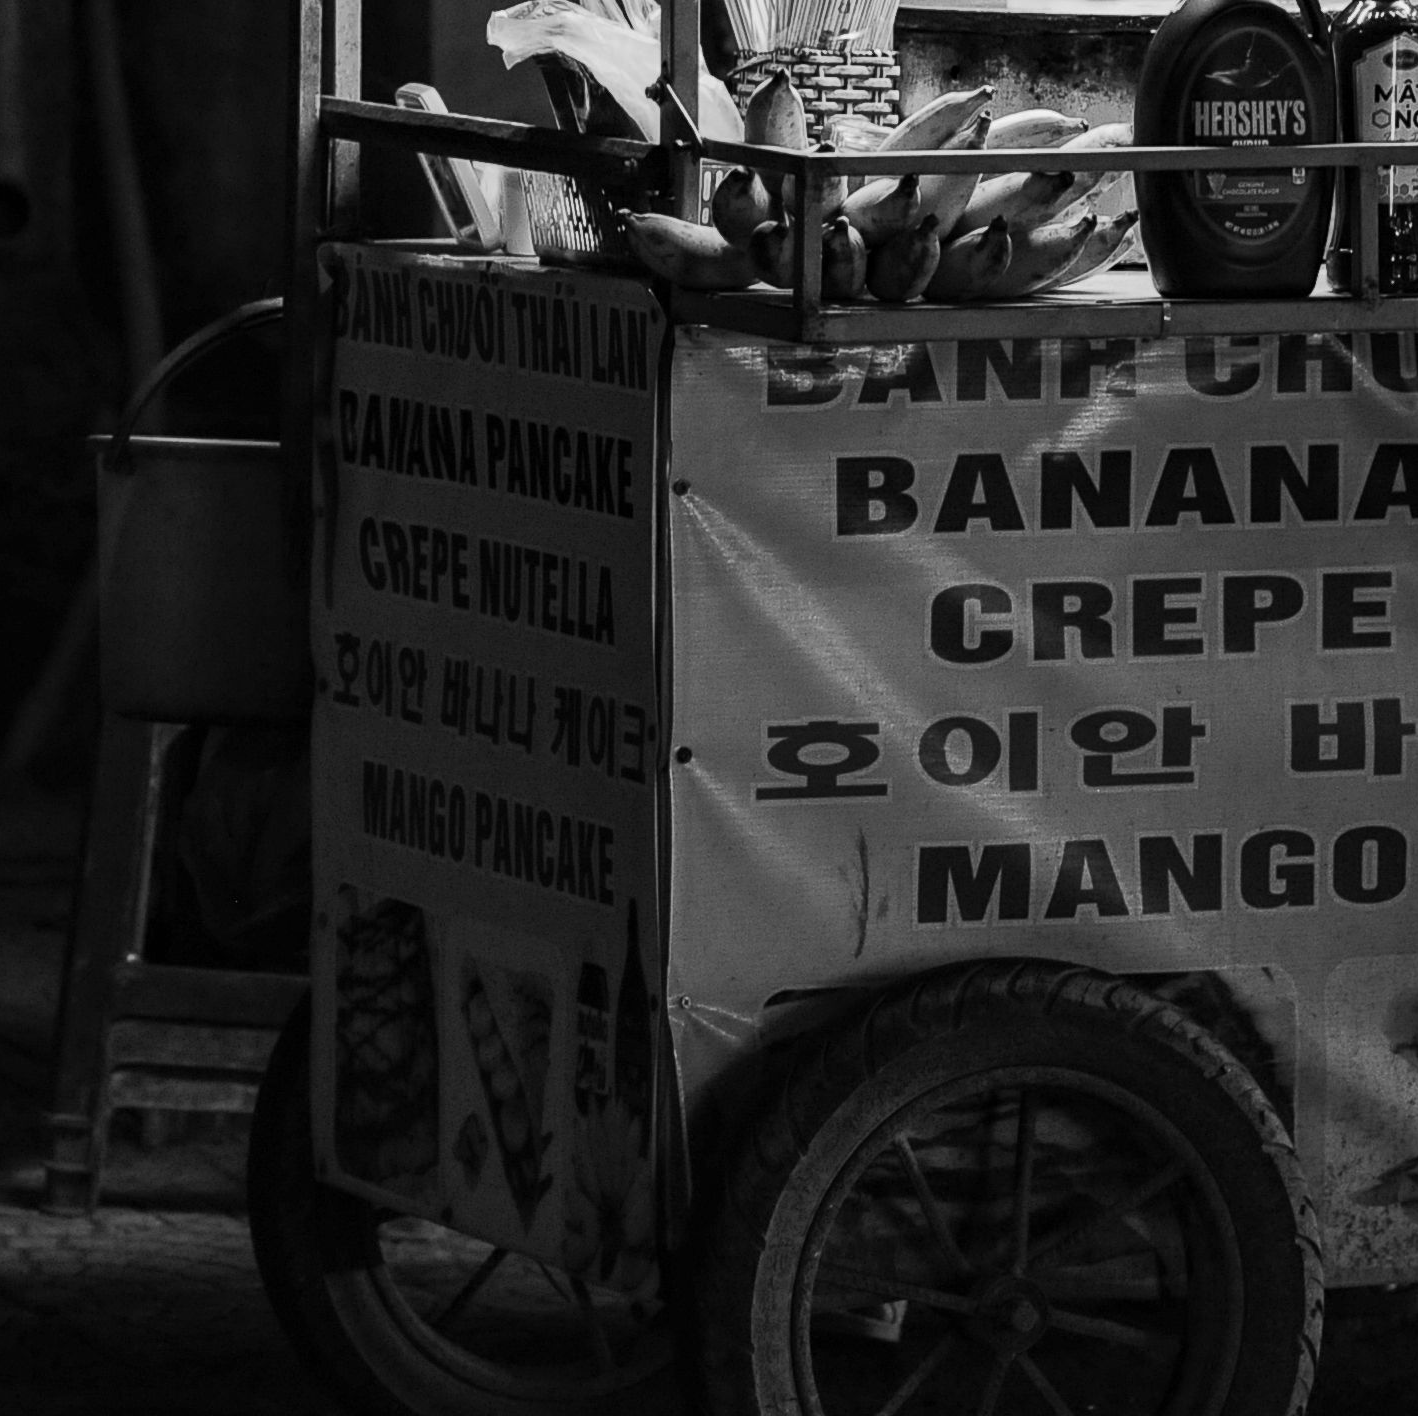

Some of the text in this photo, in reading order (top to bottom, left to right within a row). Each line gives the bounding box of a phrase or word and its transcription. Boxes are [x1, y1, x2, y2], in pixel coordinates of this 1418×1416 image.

[1194, 99, 1306, 137] HERSHEY'S
[590, 303, 648, 390] LAN
[340, 388, 633, 518] BANANA PANCAKE
[359, 517, 615, 645] CREPE NUTELLA
[930, 571, 1392, 664] CREPE
[333, 632, 646, 784] 호이안 바나나 케이크
[755, 706, 1208, 801] 호이안
[363, 761, 614, 906] MANGO PANCAKE
[916, 824, 1408, 924] MANGO
